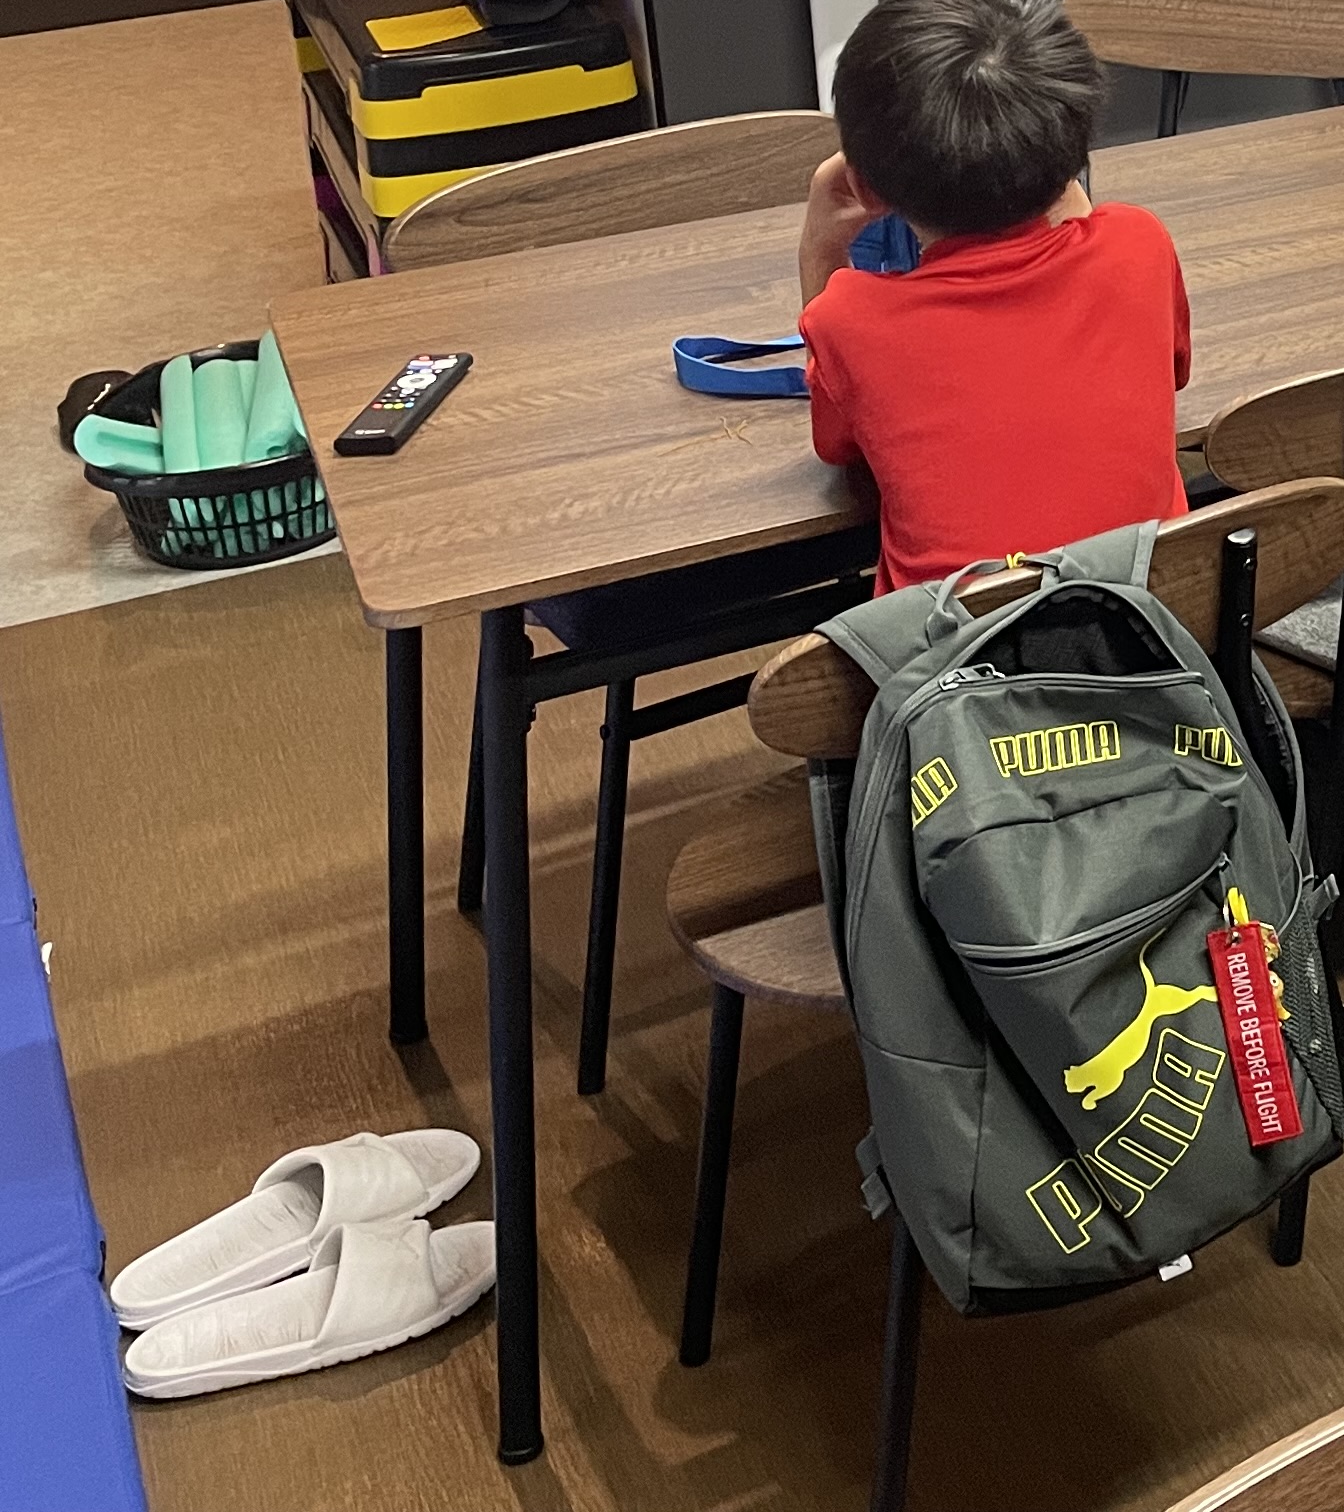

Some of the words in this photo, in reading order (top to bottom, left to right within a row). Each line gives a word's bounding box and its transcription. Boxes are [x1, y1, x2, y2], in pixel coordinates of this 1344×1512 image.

[990, 720, 1121, 778] PUMA
[1226, 952, 1257, 1017] REMOVE
[1240, 1017, 1270, 1080] BEFORE
[1253, 1080, 1283, 1134] FLIGHT
